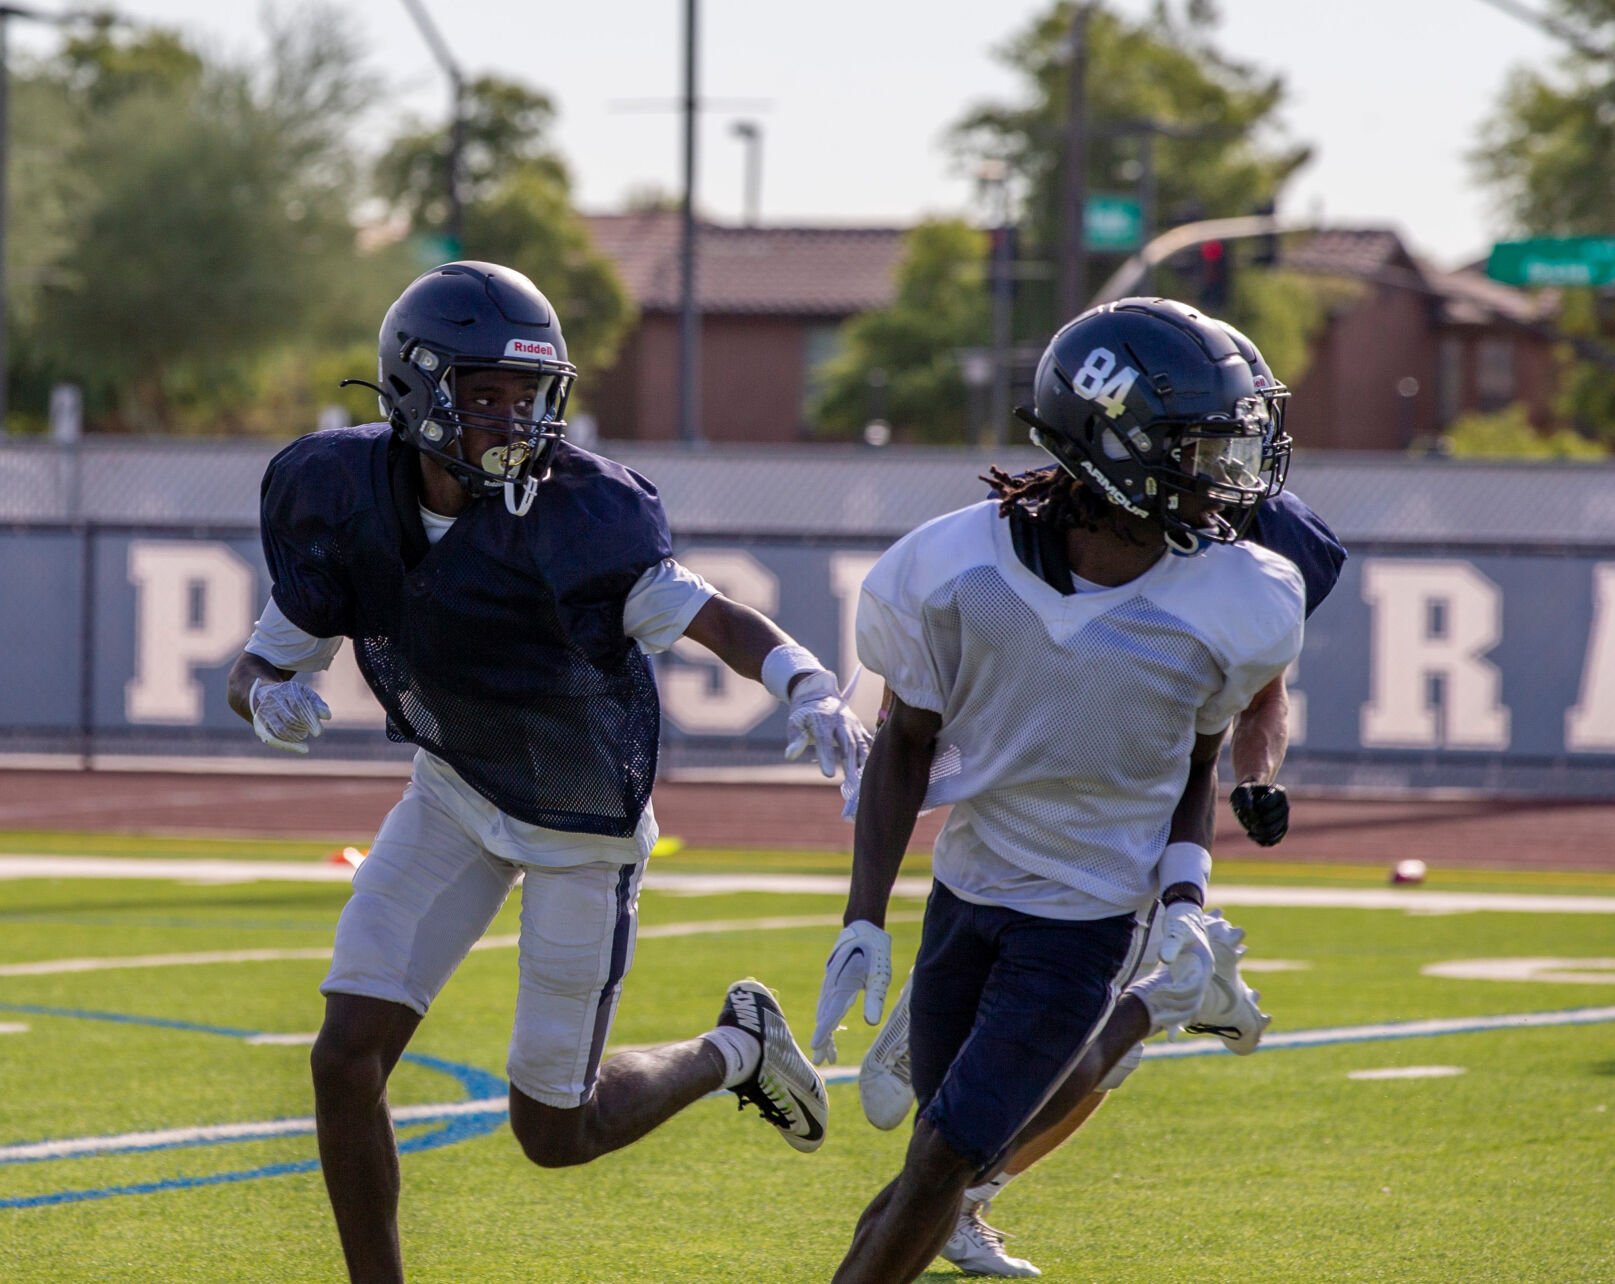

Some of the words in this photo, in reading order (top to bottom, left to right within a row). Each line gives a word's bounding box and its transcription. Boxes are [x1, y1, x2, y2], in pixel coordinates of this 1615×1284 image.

[514, 341, 553, 356] Riddell
[1072, 347, 1139, 419] 84
[1080, 461, 1150, 519] ARMOUR
[730, 990, 761, 1034] NIKE
